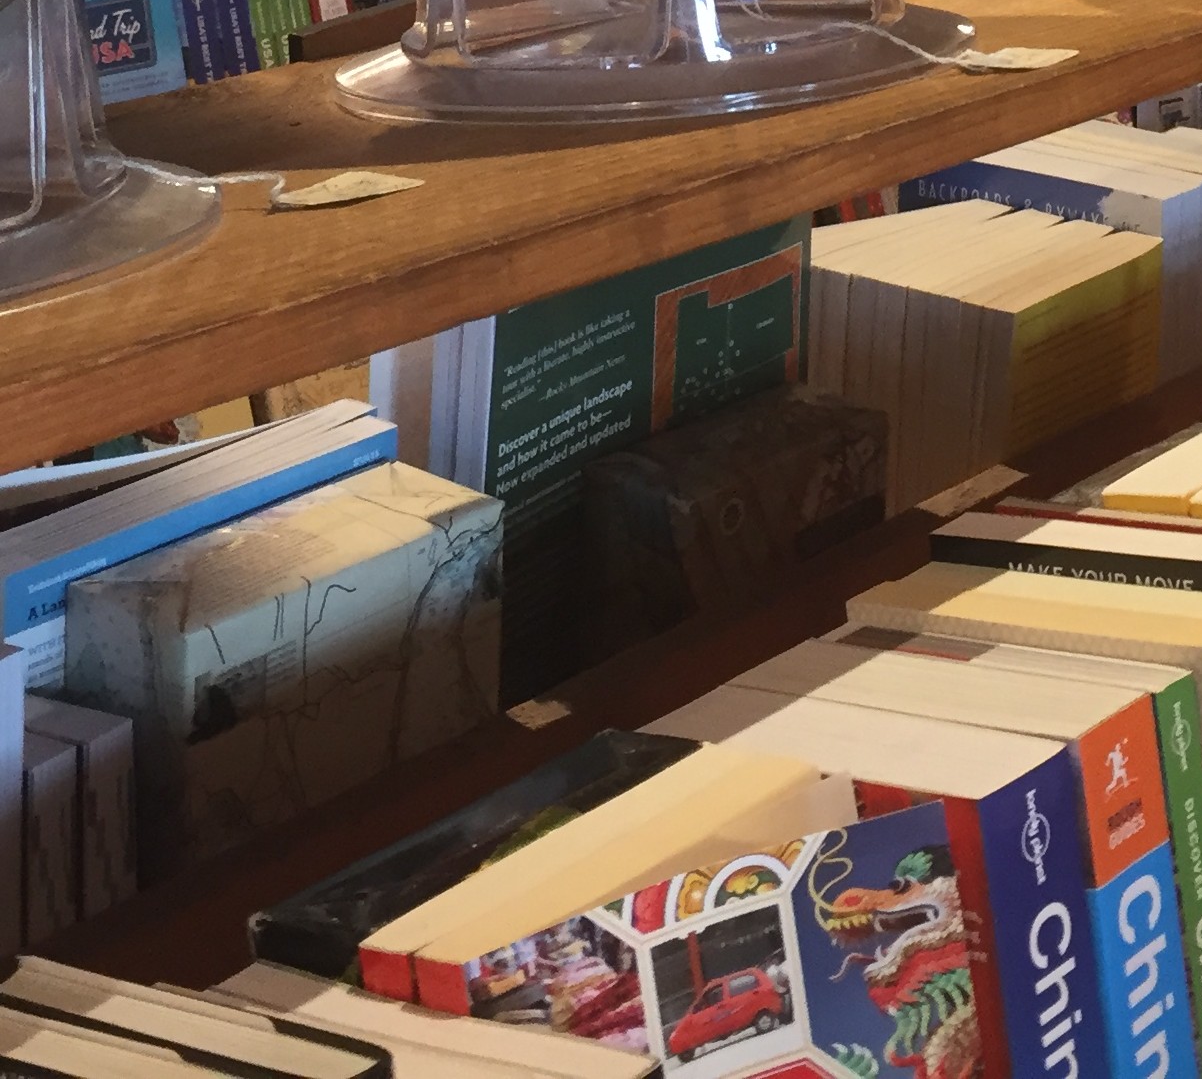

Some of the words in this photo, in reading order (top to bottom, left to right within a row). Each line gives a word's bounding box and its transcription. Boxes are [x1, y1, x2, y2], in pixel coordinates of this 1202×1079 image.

[113, 9, 141, 43] Trip
[260, 37, 275, 69] USA
[498, 426, 541, 457] Discover
[541, 422, 547, 434] a
[549, 404, 582, 430] unique
[583, 379, 633, 411] landscape
[495, 474, 518, 497] Now
[521, 444, 568, 482] expanded
[569, 434, 588, 455] and
[589, 413, 632, 446] updated
[497, 457, 516, 478] and
[517, 446, 538, 466] how
[540, 439, 548, 454] it
[550, 428, 576, 448] came
[578, 420, 588, 433] to
[1008, 561, 1064, 576] MAKE
[1135, 574, 1194, 592] MOVE
[27, 606, 39, 622] A
[1025, 788, 1040, 838] lonely
[1031, 838, 1047, 886] planet
